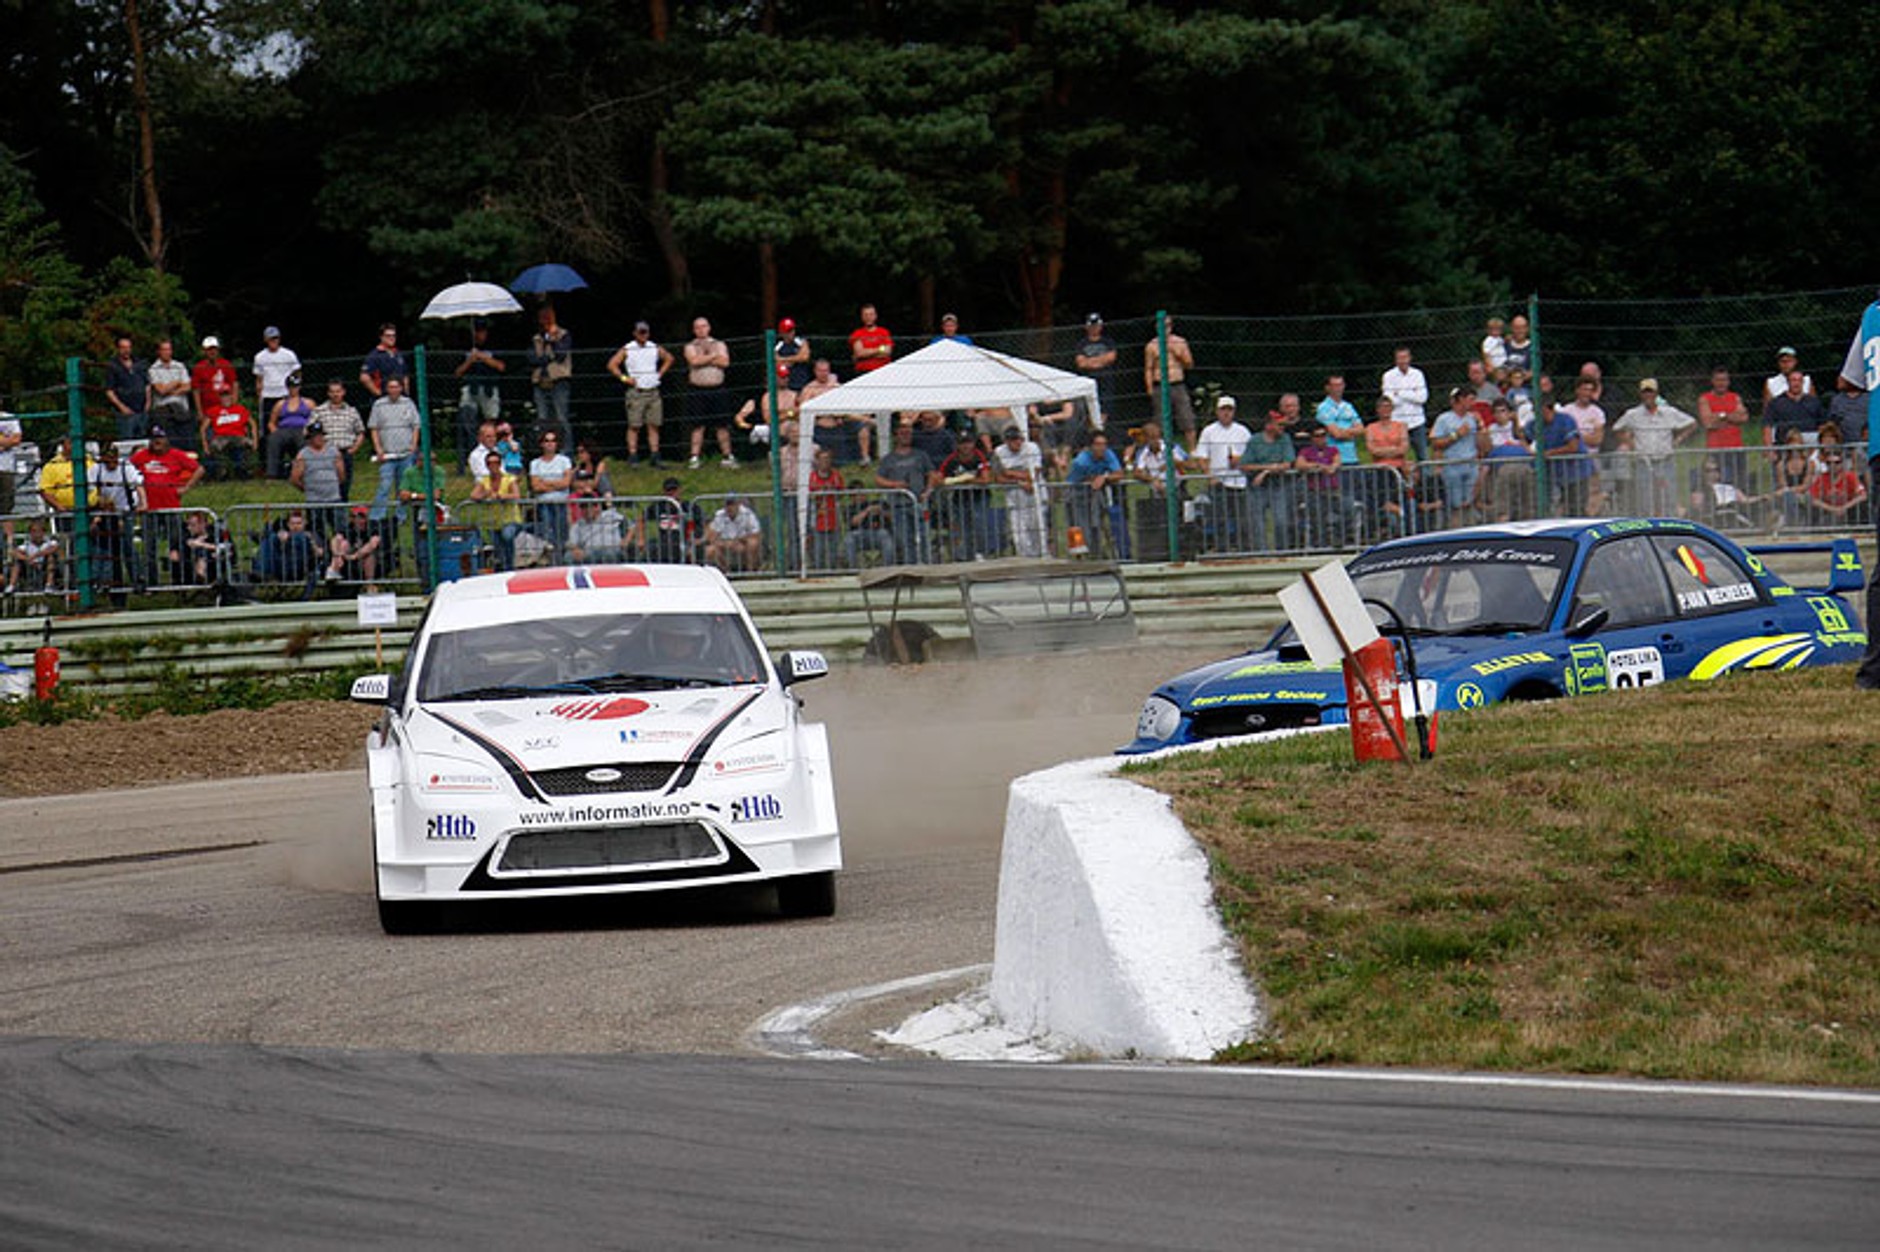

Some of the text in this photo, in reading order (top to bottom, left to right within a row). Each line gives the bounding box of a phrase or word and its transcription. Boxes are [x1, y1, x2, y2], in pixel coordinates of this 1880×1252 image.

[519, 802, 690, 824] www.informativ.no
[743, 794, 781, 818] Htb
[436, 815, 476, 837] Htb
